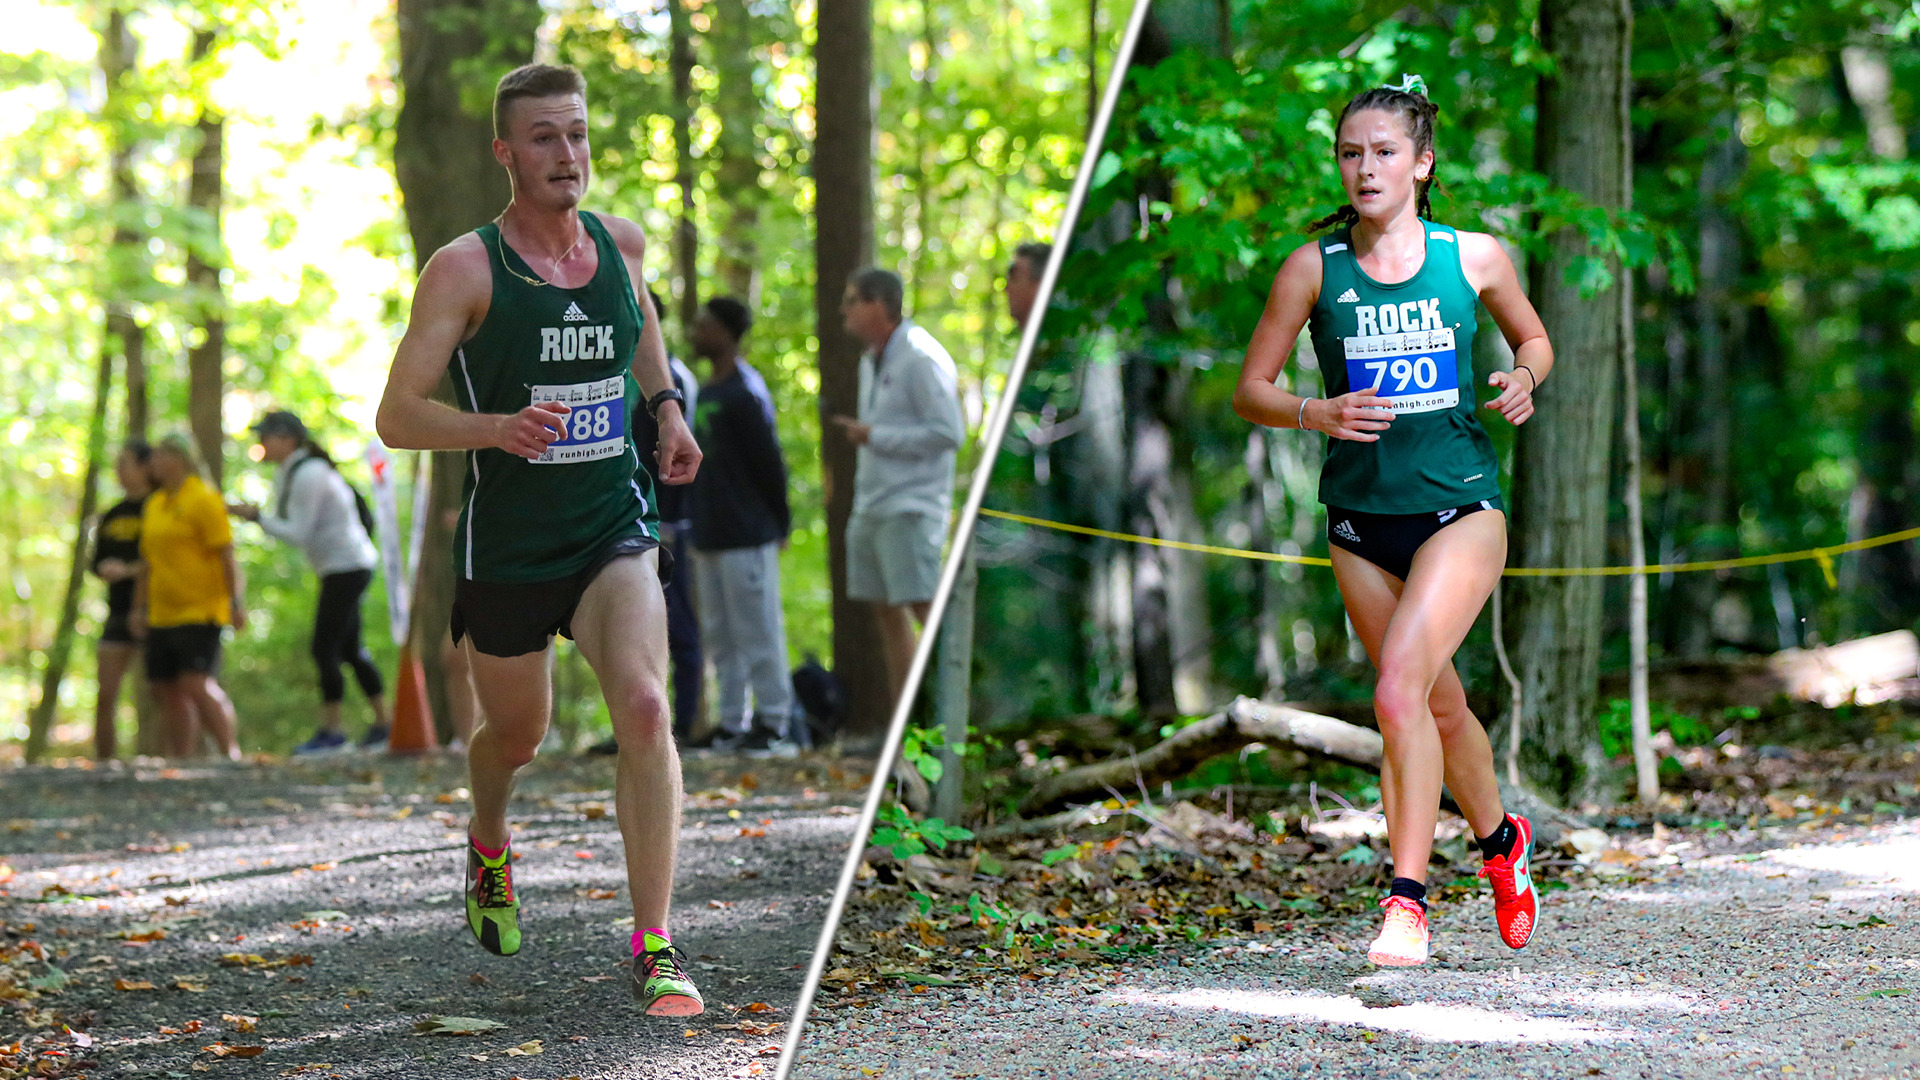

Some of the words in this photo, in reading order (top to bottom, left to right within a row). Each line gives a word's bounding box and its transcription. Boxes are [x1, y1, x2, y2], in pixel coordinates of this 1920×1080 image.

[563, 313, 588, 322] adidas
[1355, 298, 1443, 337] ROCK
[540, 325, 615, 362] ROCK
[1364, 357, 1437, 392] 790
[1382, 398, 1445, 409] nhigh.com
[560, 446, 614, 459] runhigh.com
[1333, 527, 1361, 543] adidas
